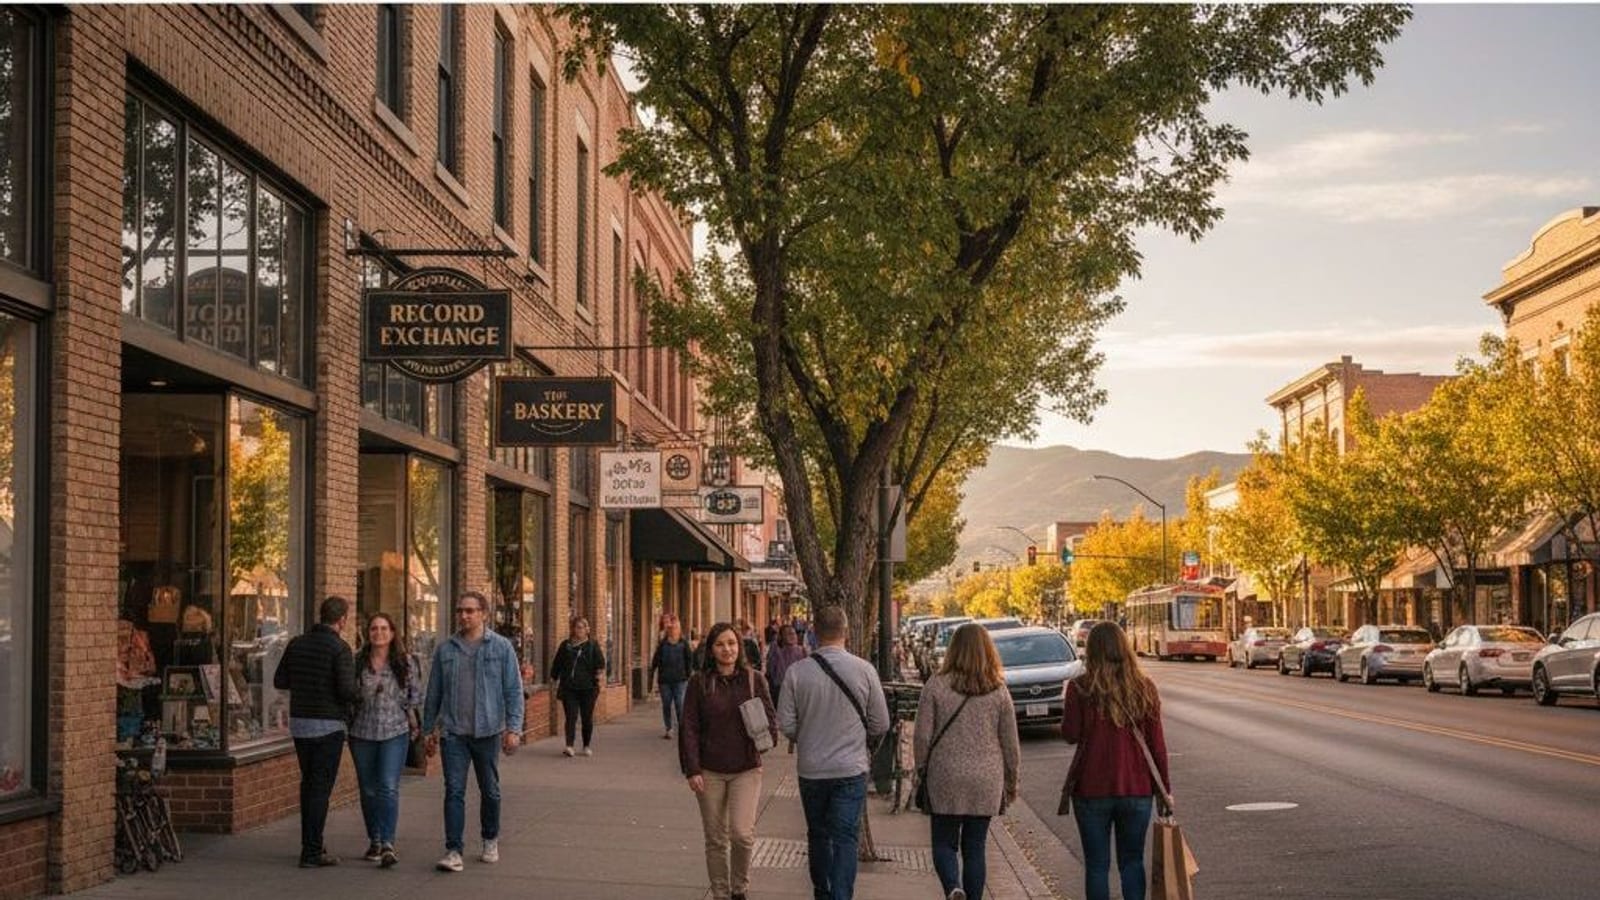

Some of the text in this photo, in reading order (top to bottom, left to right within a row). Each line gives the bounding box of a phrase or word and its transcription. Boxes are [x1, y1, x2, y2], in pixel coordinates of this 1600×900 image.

[390, 304, 485, 323] RECORD
[380, 327, 500, 346] EXCHANGE
[515, 402, 604, 420] BASKERY
